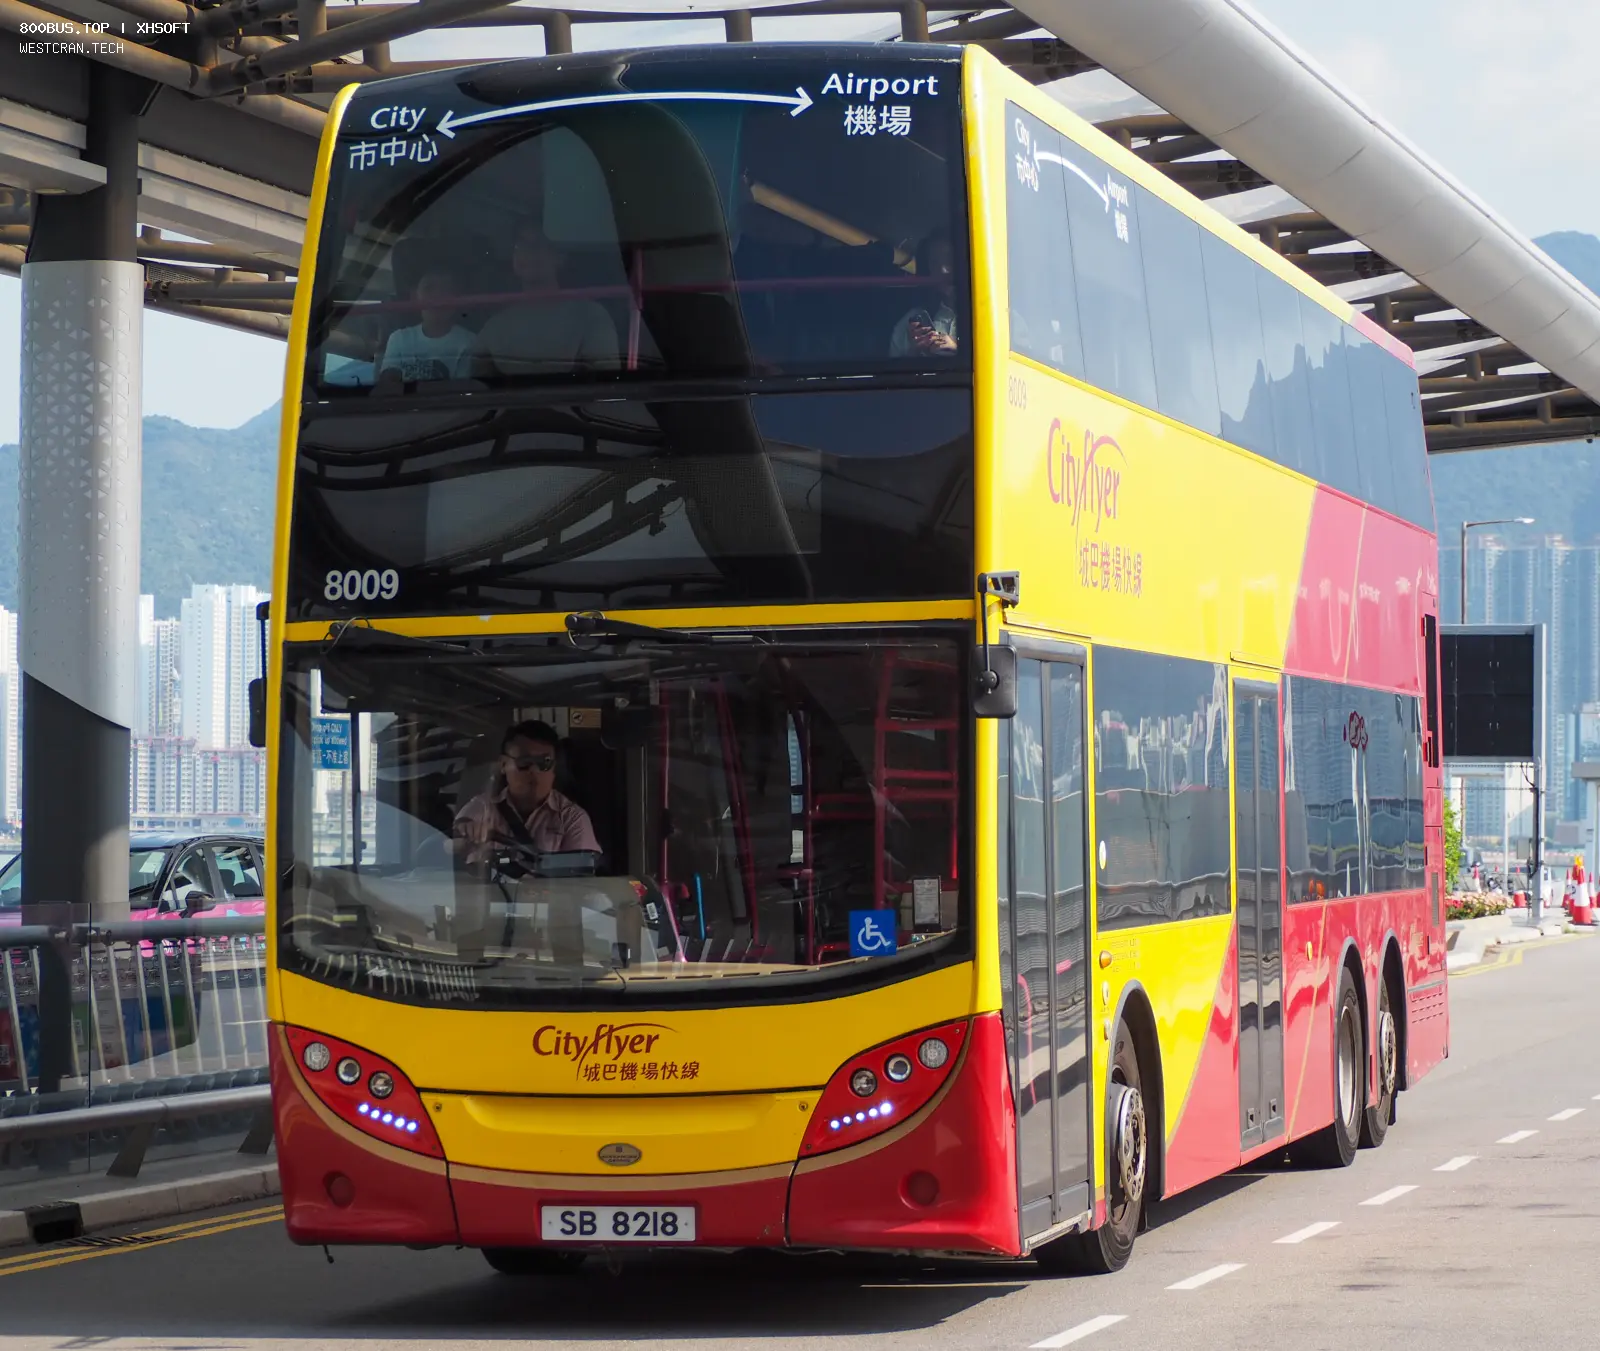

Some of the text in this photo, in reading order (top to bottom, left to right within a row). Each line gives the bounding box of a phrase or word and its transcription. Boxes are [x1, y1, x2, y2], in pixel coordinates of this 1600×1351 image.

[821, 72, 939, 102] Airport
[370, 106, 427, 132] City
[843, 104, 912, 136] 機場
[349, 133, 438, 171] 市中心
[1008, 374, 1028, 410] 8009
[323, 568, 400, 601] 8009
[583, 1060, 700, 1082] 城巴機場快線
[559, 1210, 679, 1237] SB 8218
